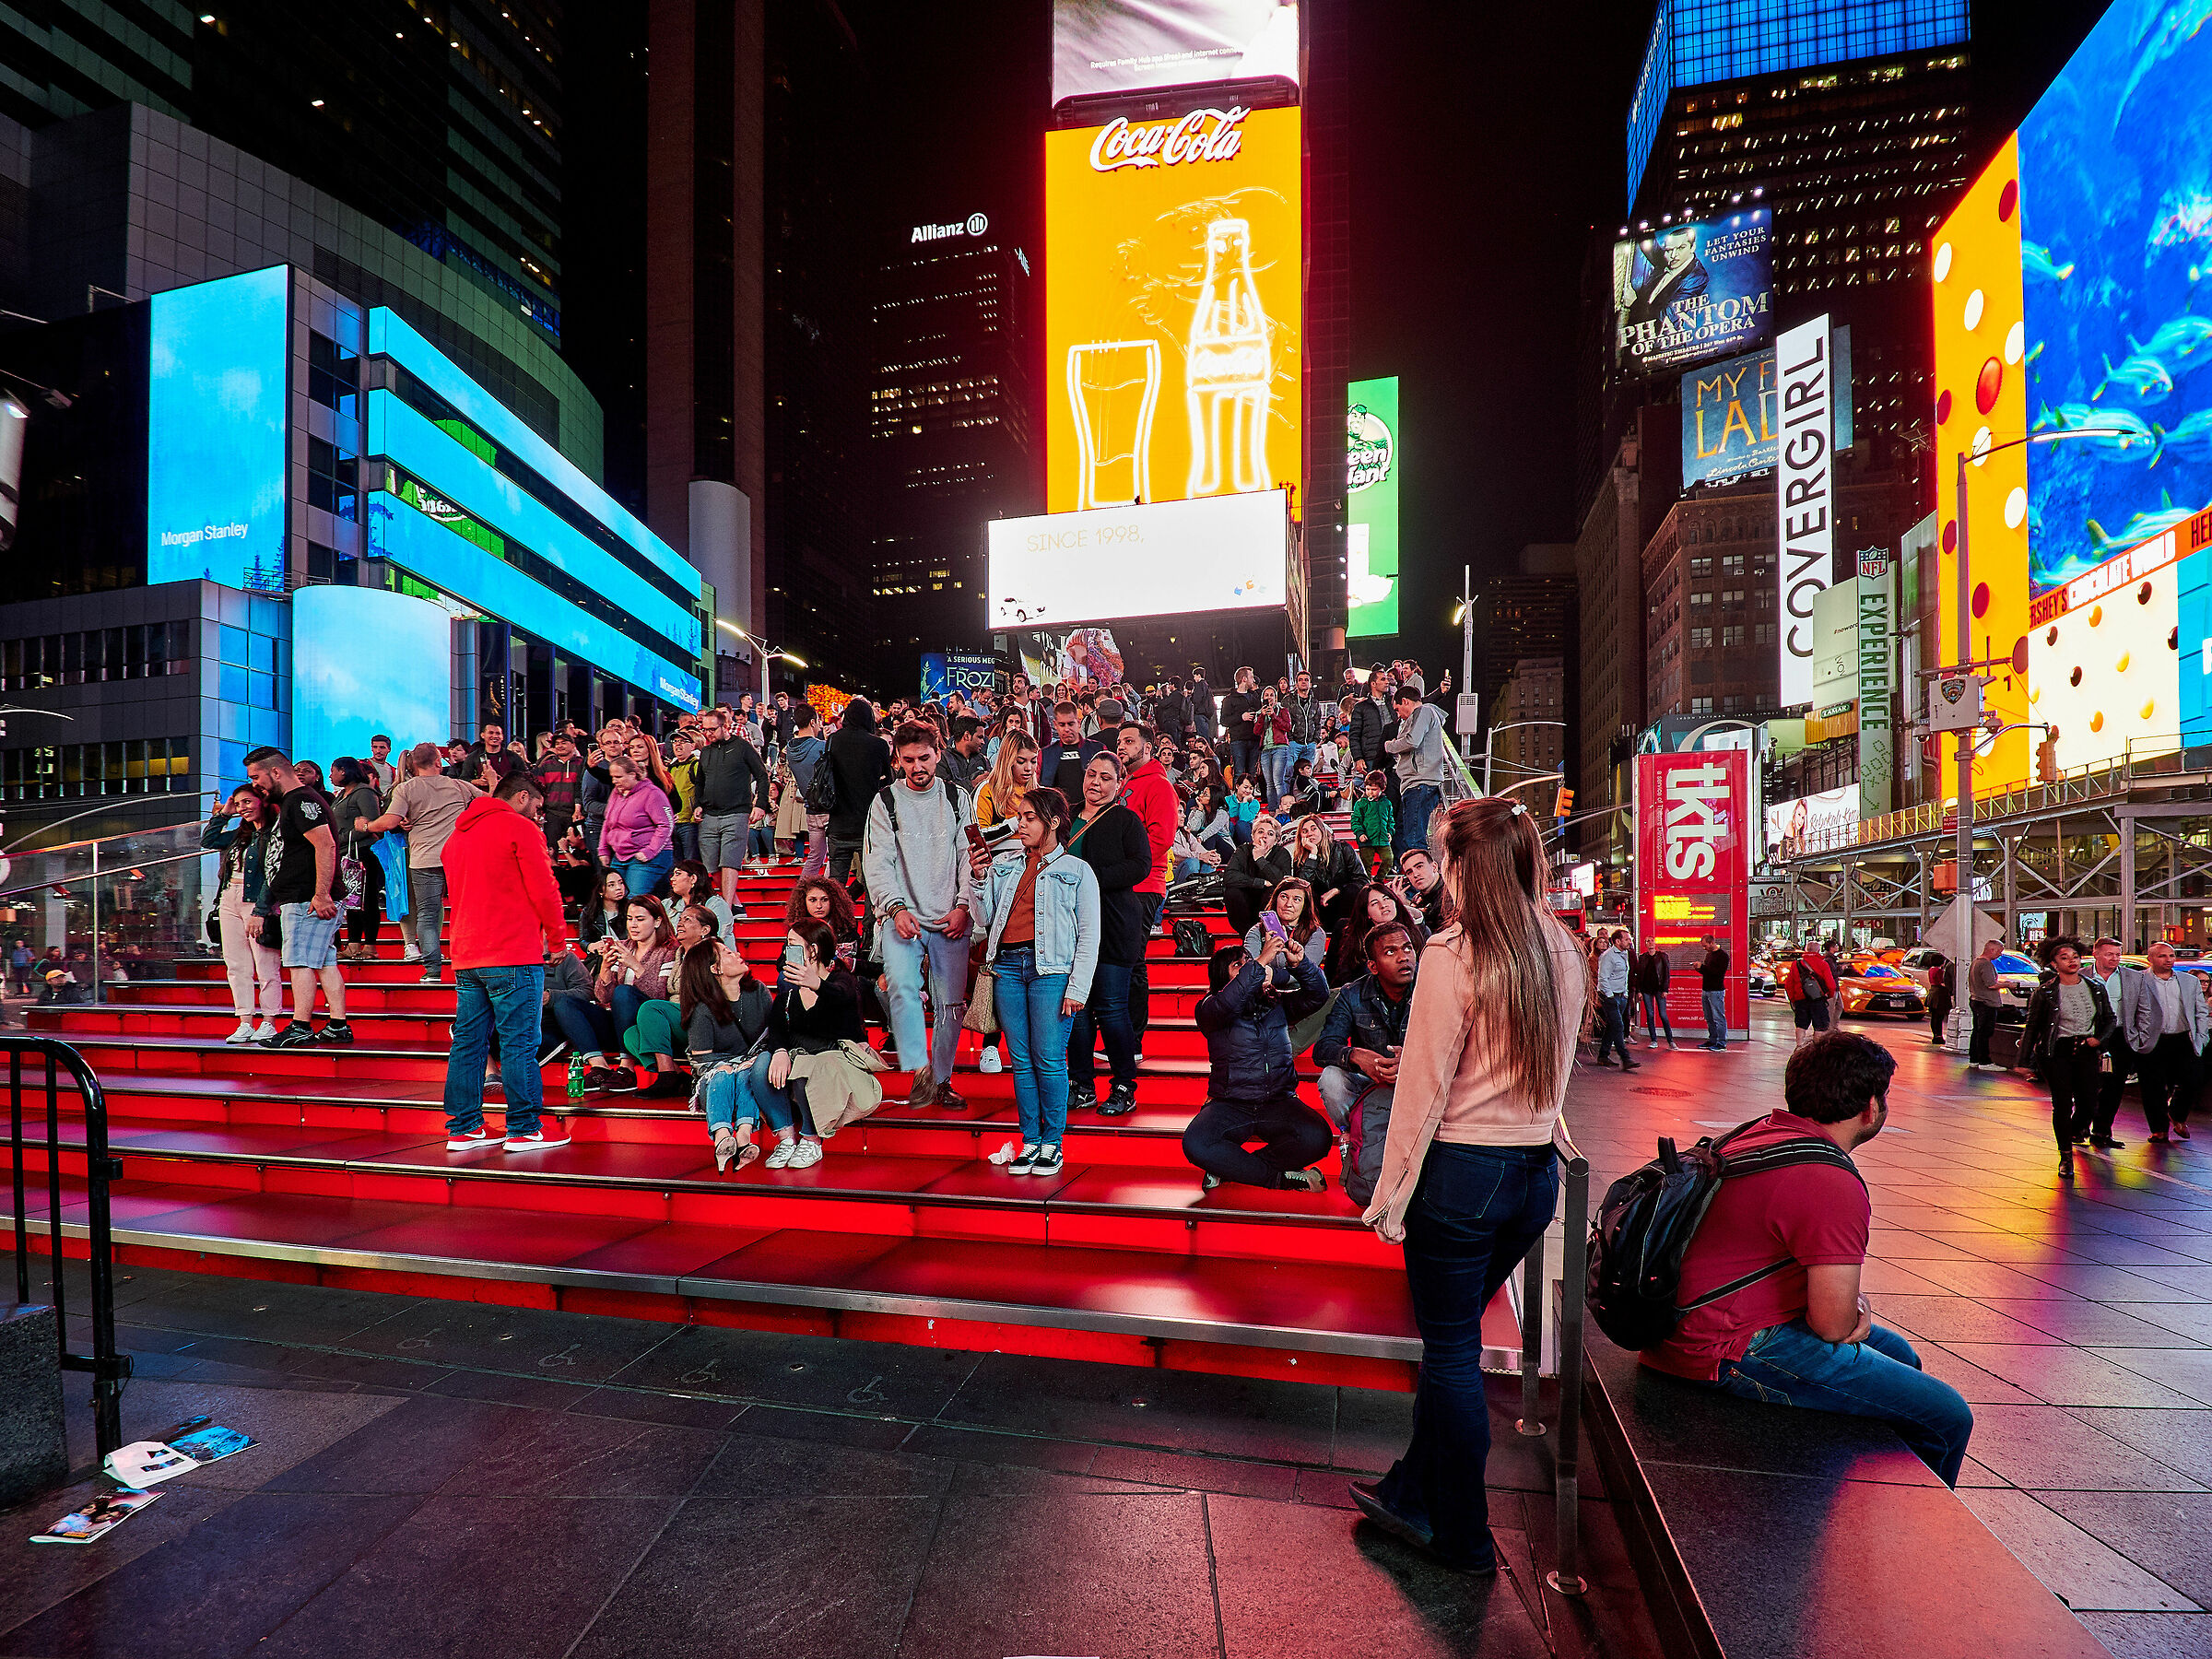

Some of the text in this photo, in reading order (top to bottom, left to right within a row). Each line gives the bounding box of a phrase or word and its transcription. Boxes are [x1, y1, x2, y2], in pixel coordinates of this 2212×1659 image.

[1089, 105, 1252, 172] Coca-Cola
[911, 222, 965, 243] Allianz
[1704, 234, 1767, 256] FANTASIES
[1706, 226, 1766, 248] LET YOUR
[1712, 244, 1759, 263] UNWIND
[1672, 294, 1711, 314] THE
[1618, 292, 1770, 347] PHANTOM
[1631, 338, 1655, 356] OF
[1657, 329, 1694, 350] THE
[1695, 316, 1756, 339] OPERA
[1696, 367, 1747, 407] MY
[1706, 462, 1747, 479] Lincoln
[1783, 335, 1828, 658] COVERGIRL
[161, 522, 249, 547] Morgan Stanley
[1027, 529, 1088, 553] SINCE
[1861, 560, 1886, 576] NFL
[2029, 587, 2068, 629] RSHEY'S
[1860, 593, 1889, 731] EXPERIENCE
[659, 677, 700, 710] Morgan Stanley
[1822, 705, 1848, 717] LAMAR
[1666, 762, 1731, 880] tkts
